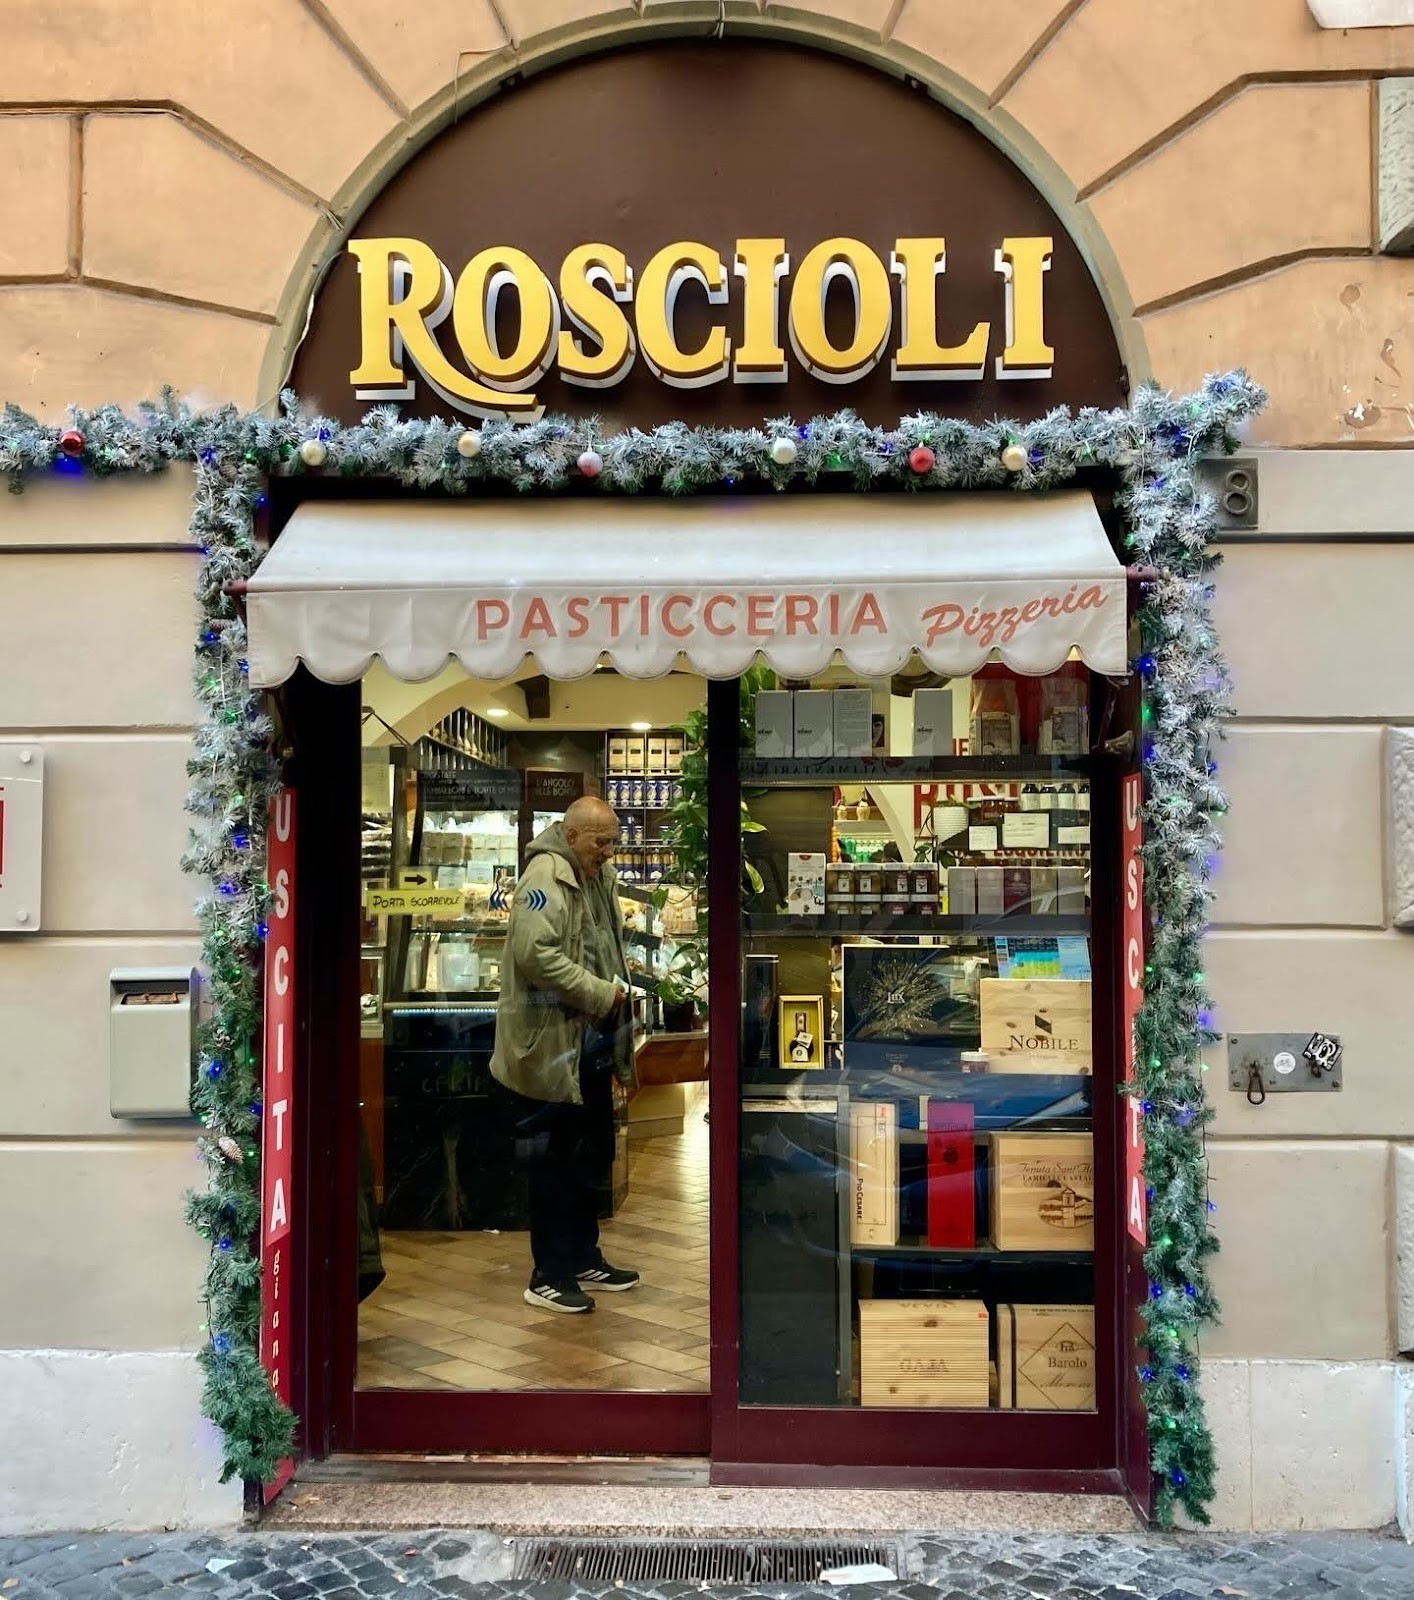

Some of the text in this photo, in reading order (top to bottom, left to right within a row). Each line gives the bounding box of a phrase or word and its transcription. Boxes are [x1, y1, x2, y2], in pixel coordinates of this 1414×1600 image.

[348, 237, 1055, 420] ROSCIOLI
[476, 584, 1108, 648] PASTICCERIA Pizzeria
[373, 895, 460, 909] PORTA SCORREVOLE
[270, 793, 292, 1234] USCITA
[1009, 1034, 1080, 1051] NOBILE
[1049, 1356, 1088, 1368] Barolo
